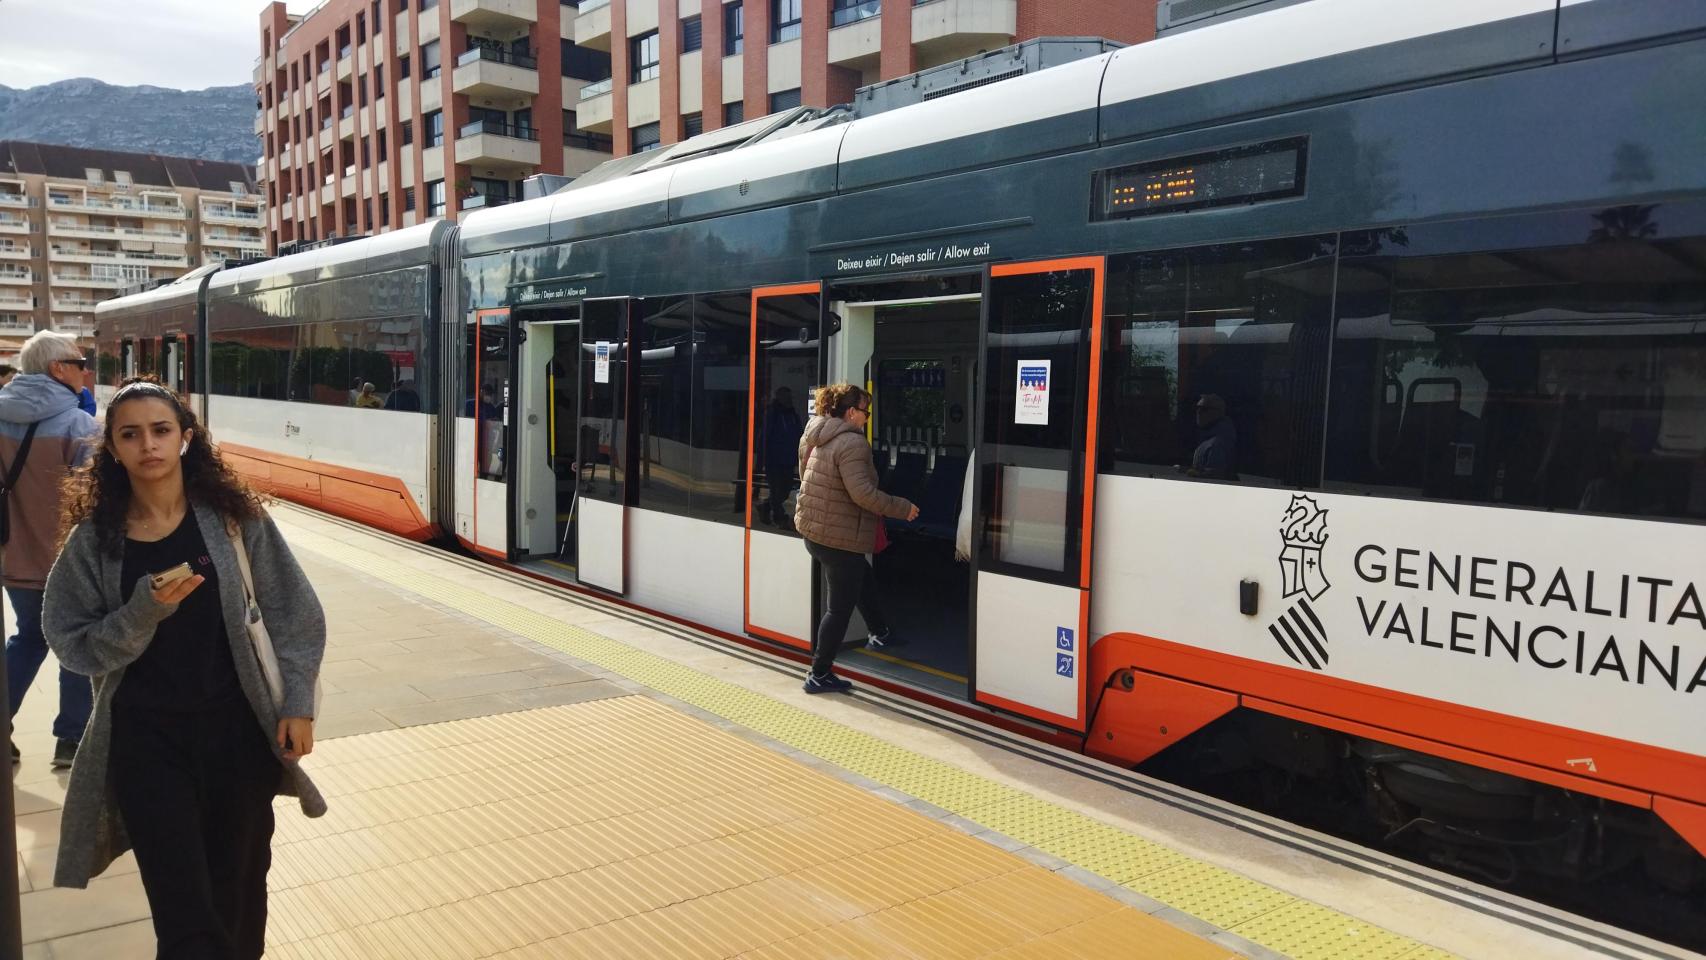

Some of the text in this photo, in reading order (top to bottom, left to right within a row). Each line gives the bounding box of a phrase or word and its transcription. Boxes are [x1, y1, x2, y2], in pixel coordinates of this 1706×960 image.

[837, 259, 863, 270] Deixeu
[866, 255, 883, 268] eixir
[890, 253, 915, 267] Dejen
[917, 249, 936, 261] salir
[944, 245, 970, 259] Allow
[973, 242, 990, 256] exit
[1353, 544, 1706, 630] GENERALITA
